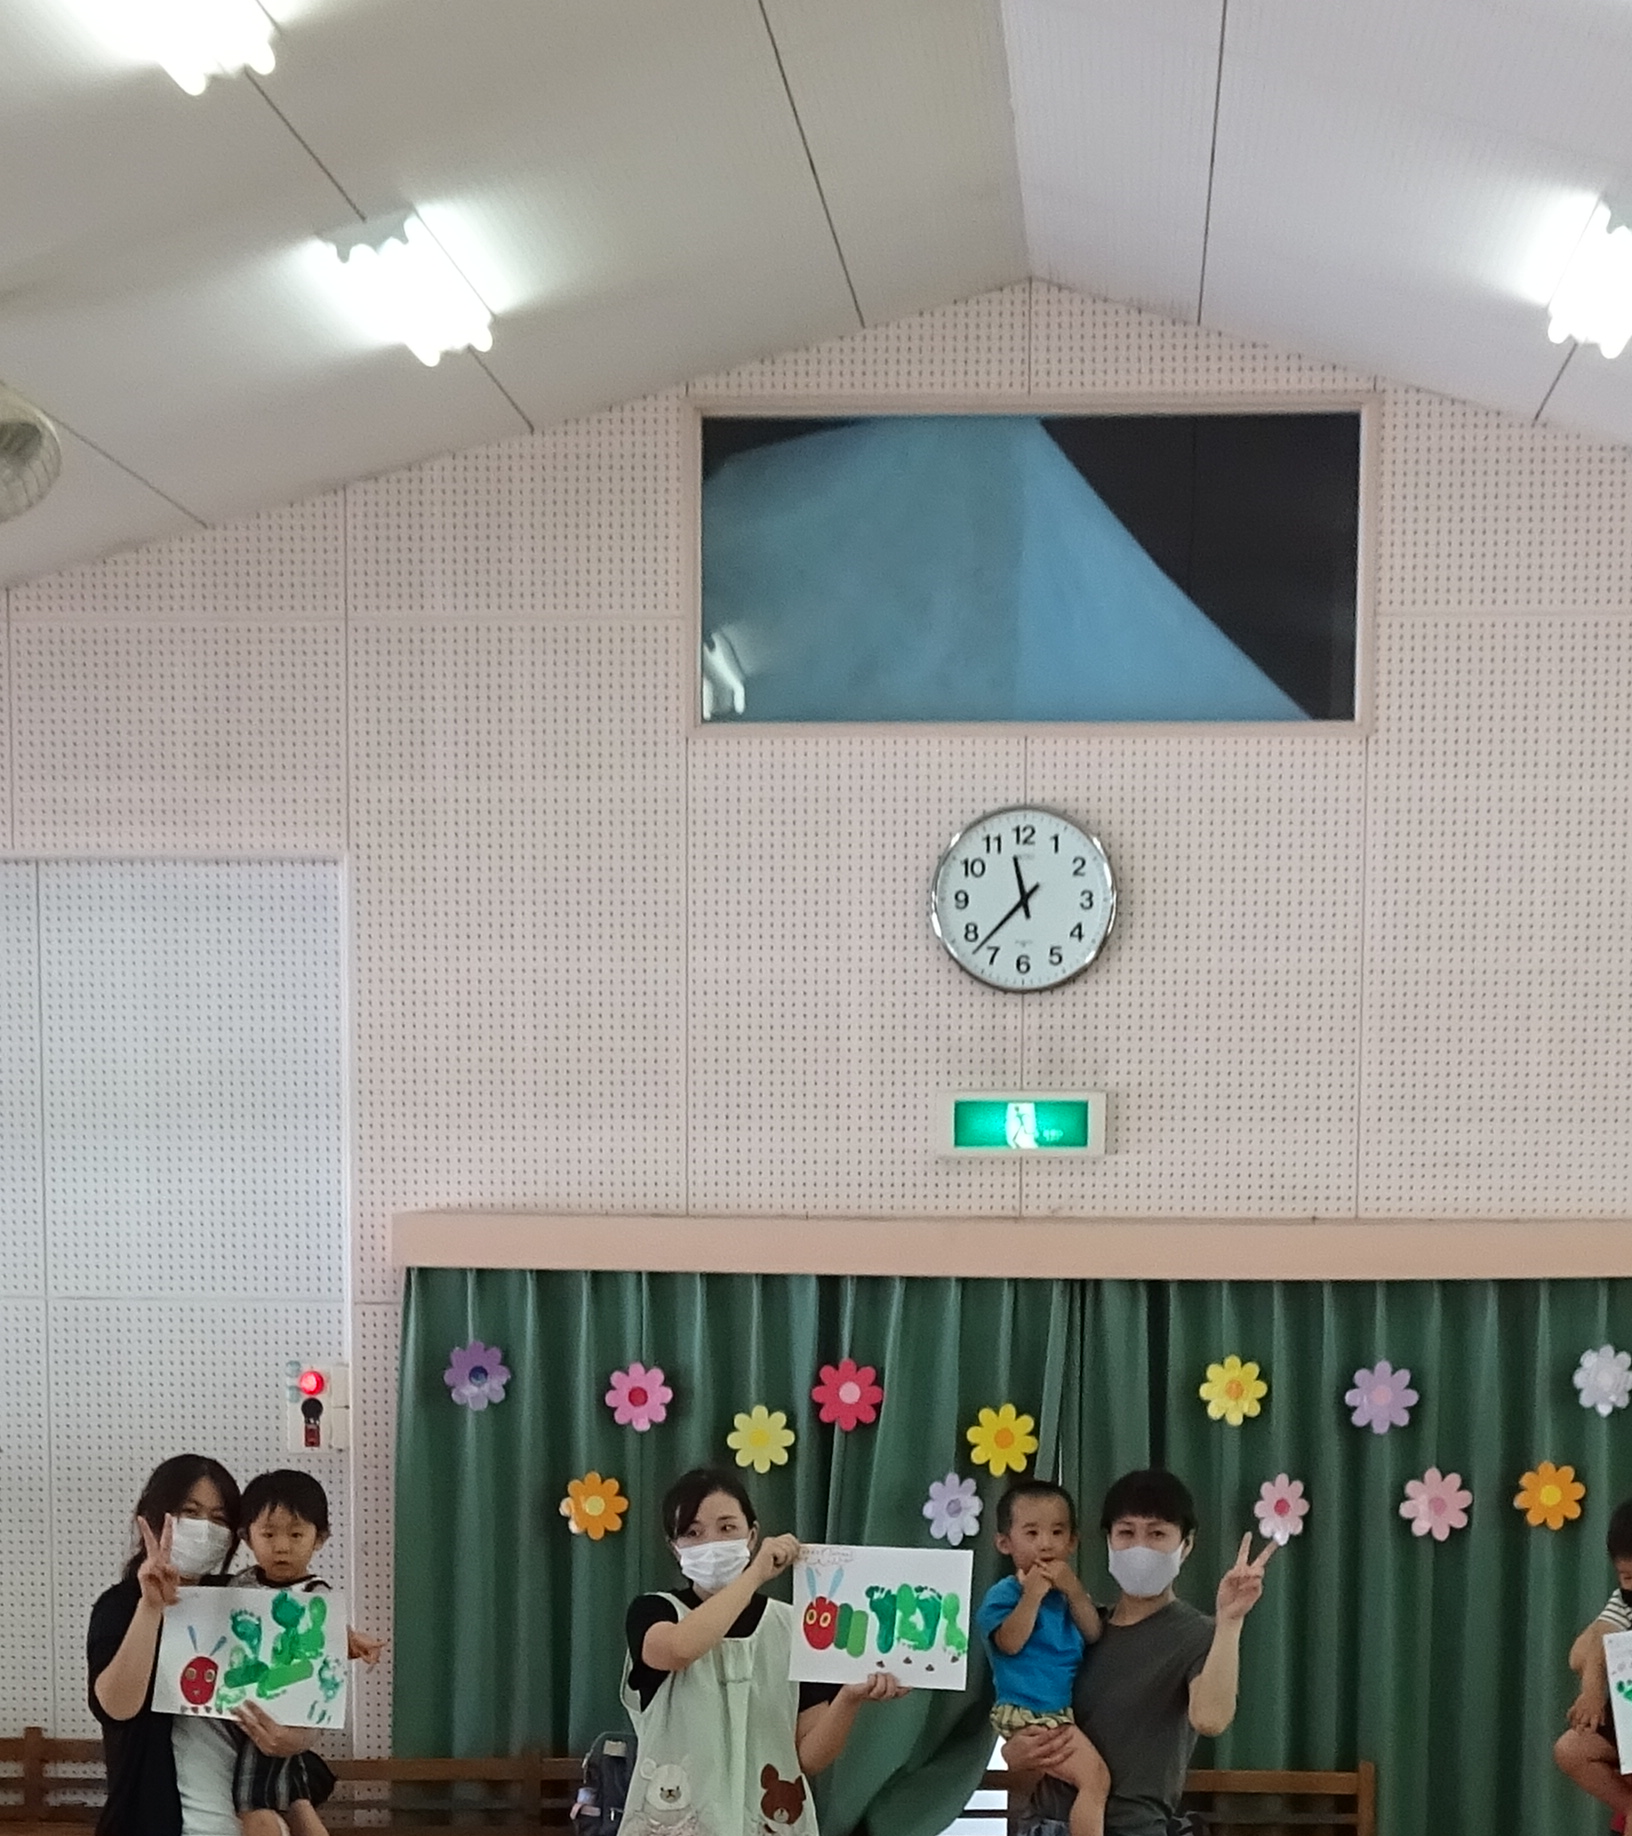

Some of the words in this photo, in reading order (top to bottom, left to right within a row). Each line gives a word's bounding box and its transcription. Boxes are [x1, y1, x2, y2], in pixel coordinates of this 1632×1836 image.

[983, 834, 1003, 854] 11
[1012, 825, 1036, 846] 12
[1050, 833, 1059, 854] 1
[962, 858, 986, 878] 10
[1072, 856, 1087, 877] 2
[954, 889, 969, 910] 9
[1079, 890, 1094, 910] 3
[964, 922, 979, 942] 8
[1070, 922, 1084, 942] 4
[986, 946, 1001, 966] 7
[1016, 954, 1031, 974] 6
[1049, 946, 1063, 966] 5
